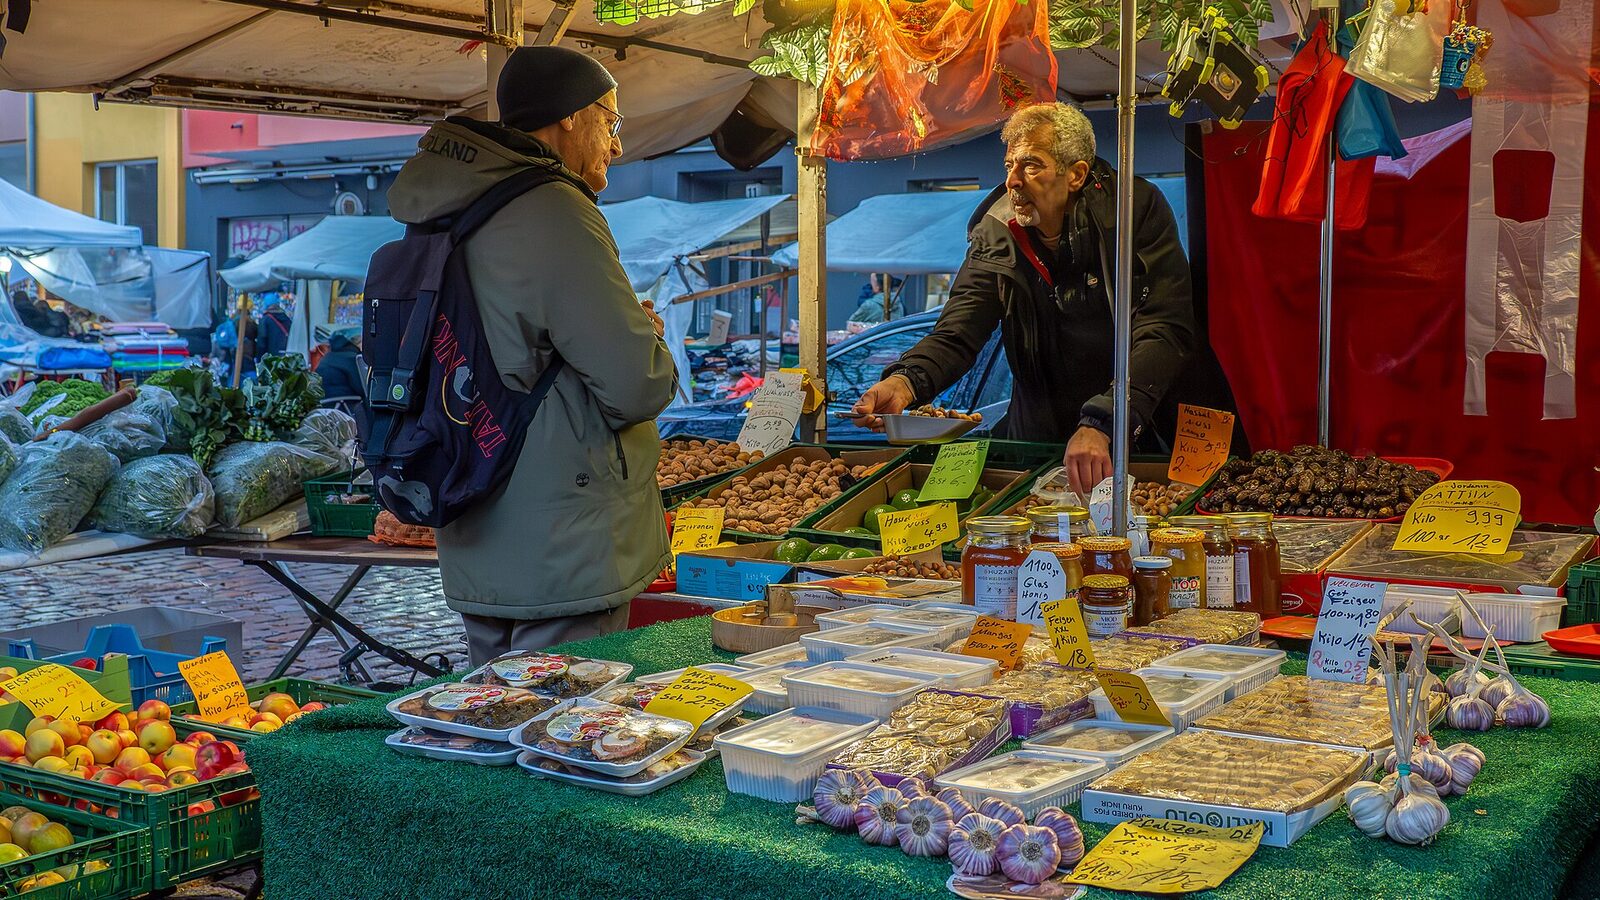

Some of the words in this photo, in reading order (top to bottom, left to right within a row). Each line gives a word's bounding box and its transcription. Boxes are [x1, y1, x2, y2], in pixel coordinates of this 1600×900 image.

[429, 134, 478, 164] LAND
[1411, 511, 1436, 525] Kilo
[1023, 576, 1049, 589] Glas
[1318, 630, 1343, 647] Kilo
[203, 707, 222, 717] Kilo
[1093, 807, 1110, 816] FIGS
[1111, 809, 1134, 819] DRIED
